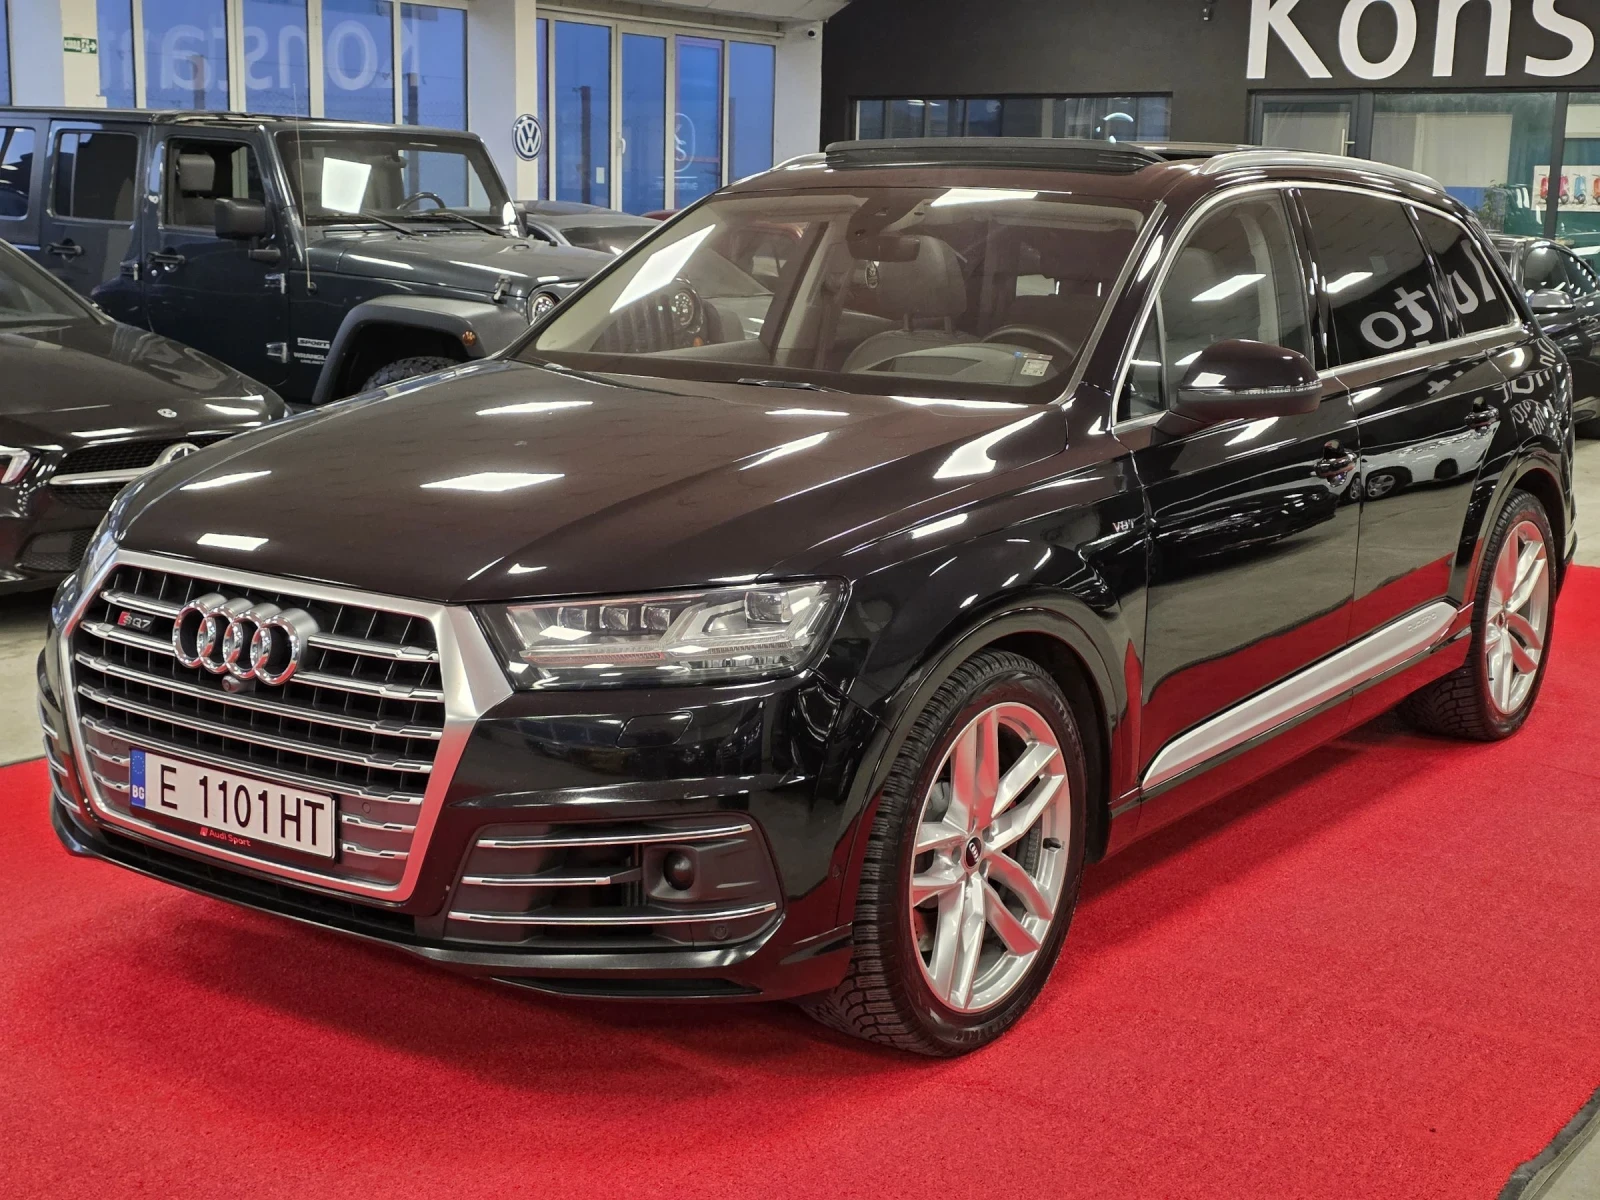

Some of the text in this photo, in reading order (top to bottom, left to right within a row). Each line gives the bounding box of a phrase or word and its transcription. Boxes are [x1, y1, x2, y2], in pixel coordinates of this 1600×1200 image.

[1246, 0, 1595, 80] Kons
[298, 338, 330, 348] SPORT
[132, 784, 145, 800] BG
[160, 764, 178, 810] E
[209, 829, 251, 847] Audi Sport
